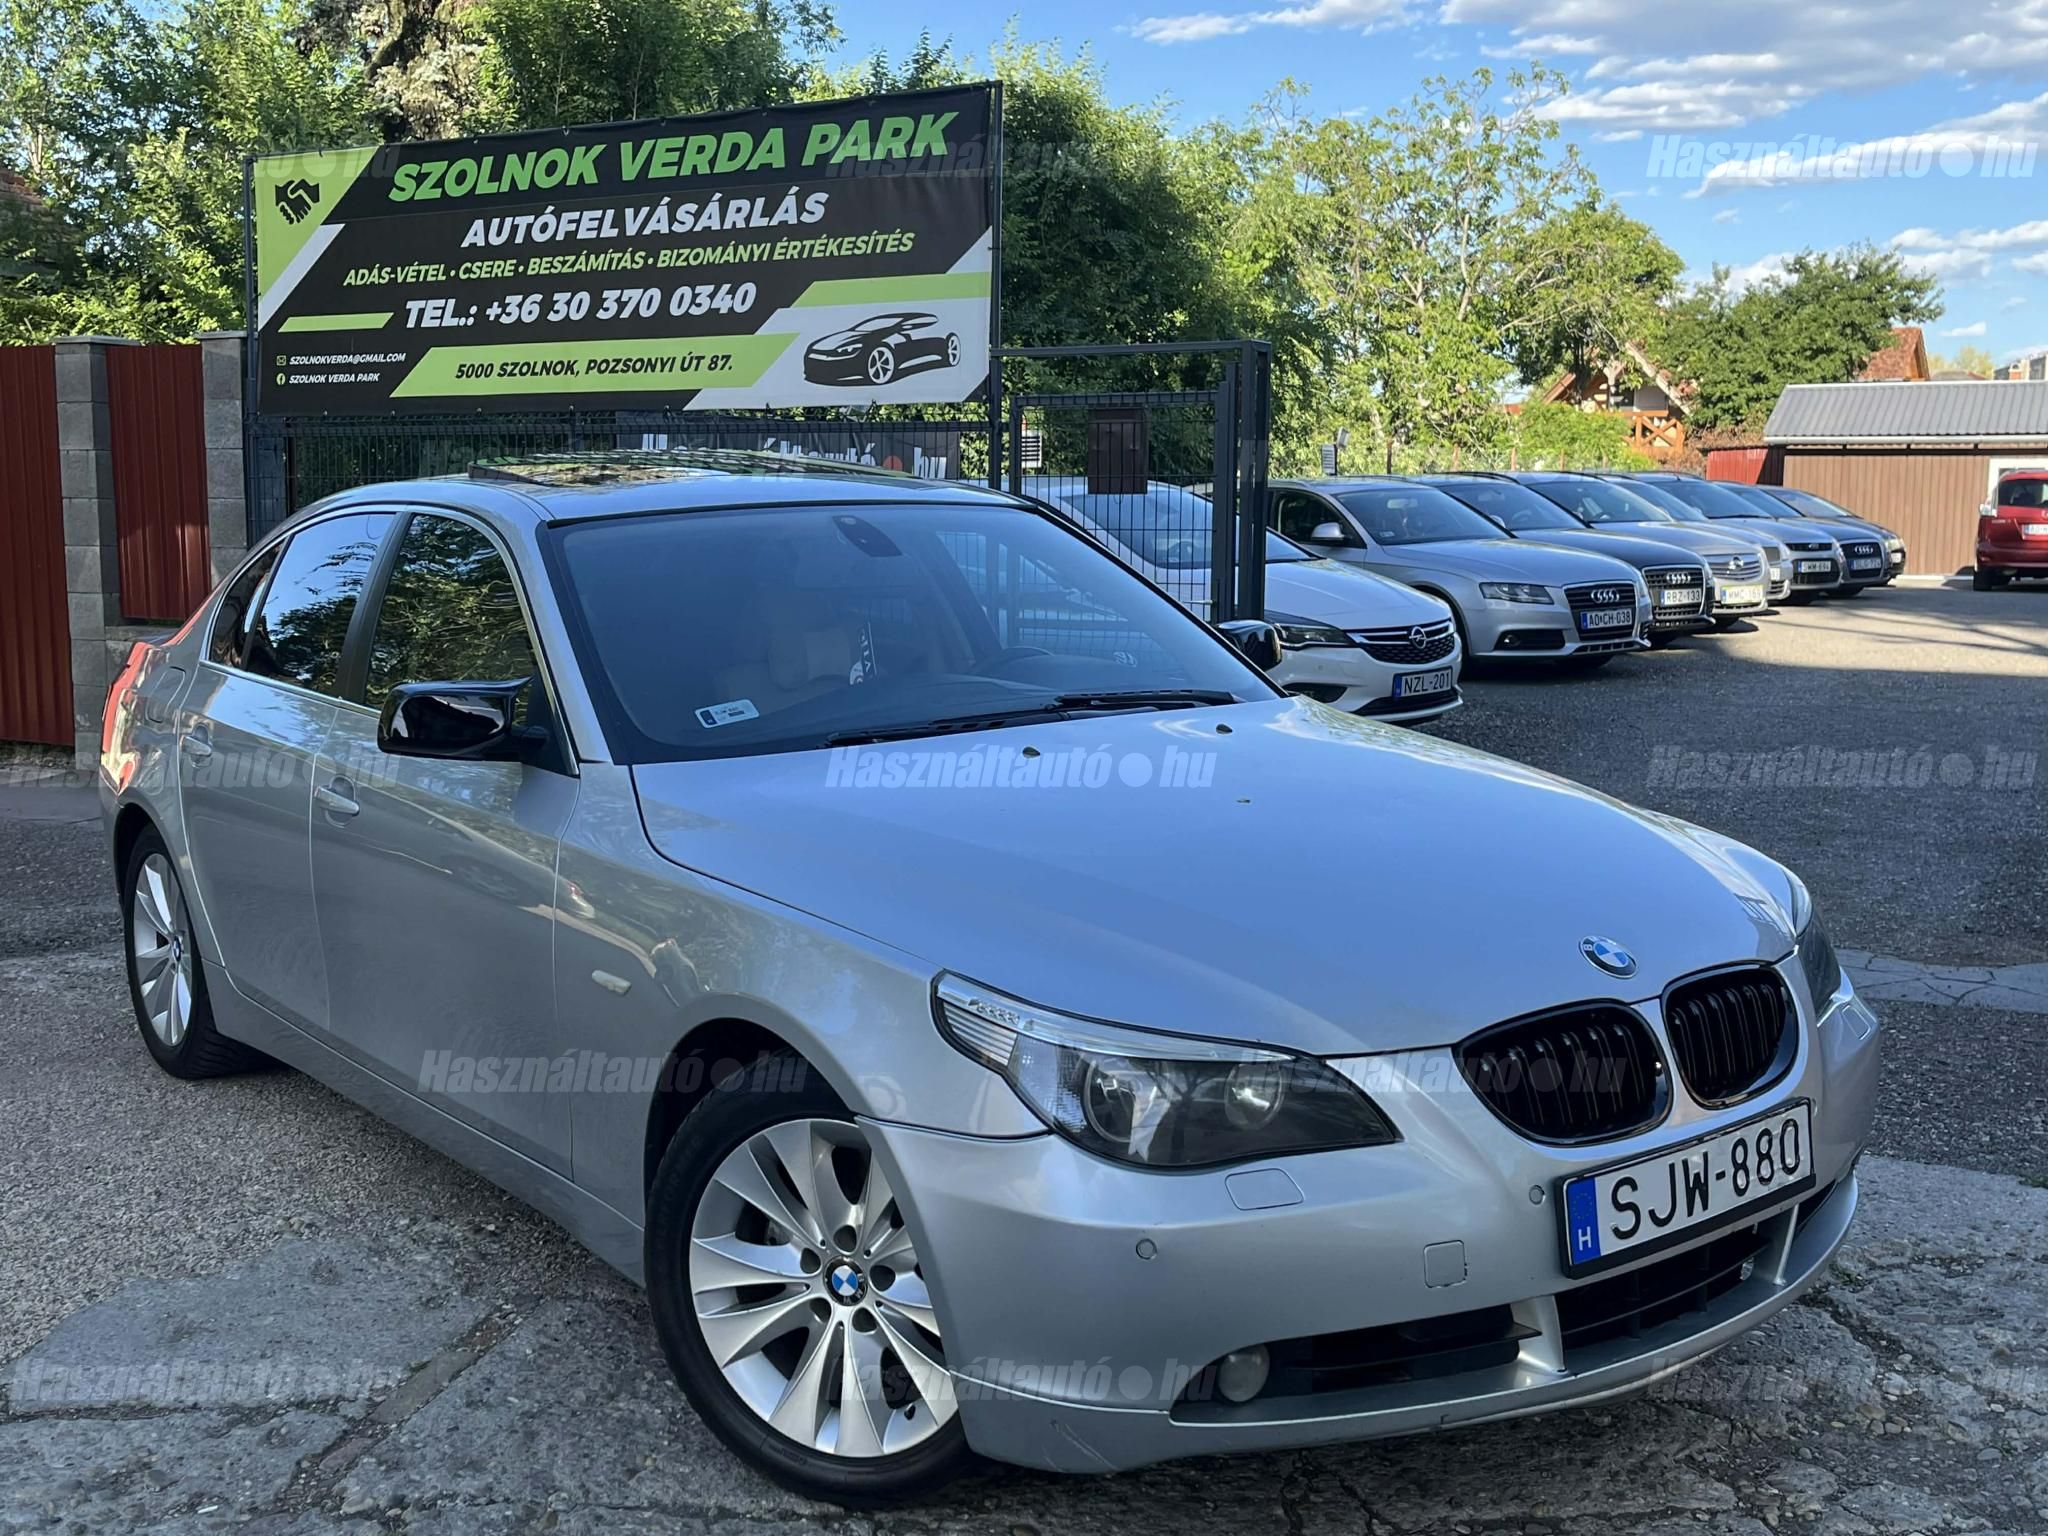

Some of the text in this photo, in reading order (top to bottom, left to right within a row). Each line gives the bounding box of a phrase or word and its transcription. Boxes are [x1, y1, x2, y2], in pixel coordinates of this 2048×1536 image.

[388, 111, 960, 202] SZOLNOK VERDA PARK
[460, 185, 830, 248] AUTÓFELVÁSÁRLÁS
[342, 228, 916, 287] ADÁS-VÉTEL CSERE BESZÁMÍTÁS BIZOMÁNYI ÉRTÉKESÍTÉS
[405, 282, 757, 329] TEL.: +36 30 370 0340
[289, 353, 406, 365] SZOLNOKVERDA@GMAIL.COM
[455, 351, 734, 379] 5000 SZOLNOK, POZSONYI ÚT 87.
[289, 373, 380, 384] SZOLNOK VERDA PARK
[1665, 590, 1701, 603] RBZ-133
[1403, 672, 1450, 695] NZL-201
[1610, 1118, 1800, 1240] SJW-880
